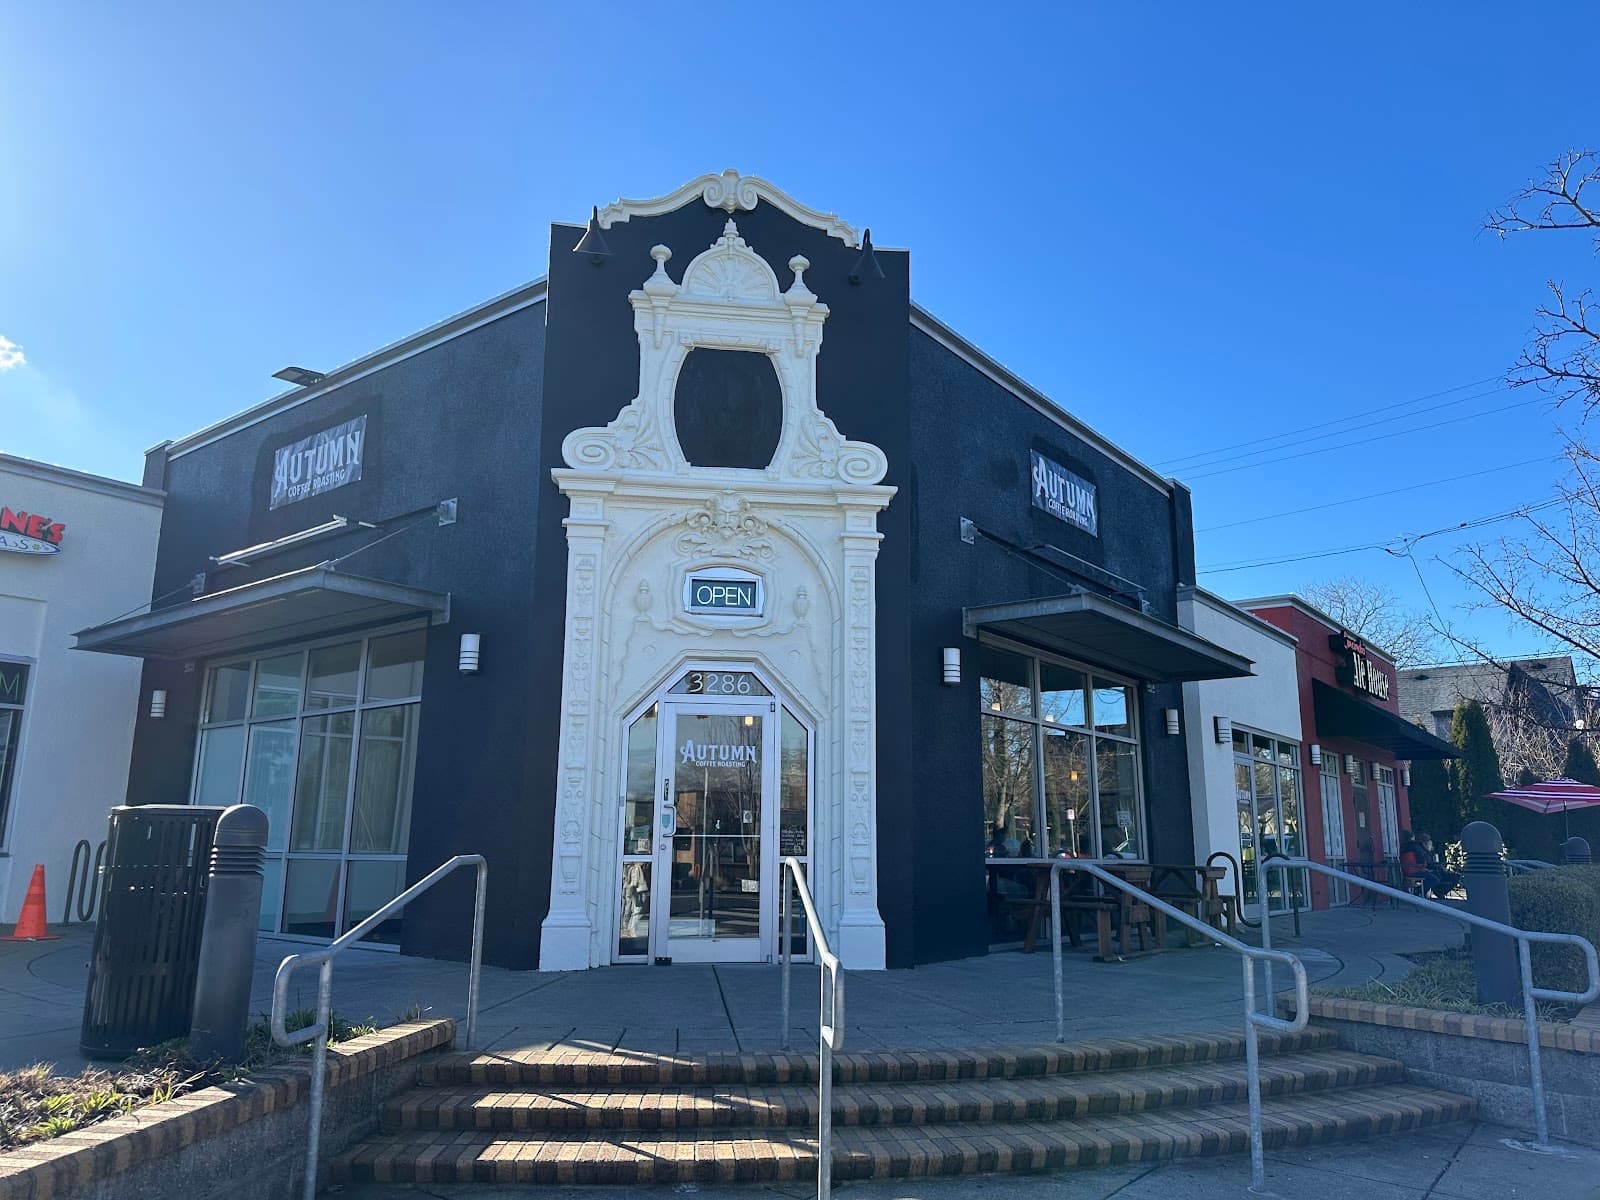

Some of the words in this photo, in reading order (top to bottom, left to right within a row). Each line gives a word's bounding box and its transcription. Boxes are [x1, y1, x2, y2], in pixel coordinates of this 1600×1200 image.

[273, 431, 361, 498] AUTUMN
[287, 480, 312, 498] COFFEE
[312, 469, 345, 490] ROASTING
[1032, 456, 1096, 525] AUTUMN
[1065, 507, 1089, 527] ROAING
[696, 585, 752, 607] OPEN
[688, 673, 750, 694] 3286
[1352, 651, 1367, 690] Ale
[1366, 659, 1390, 701] House
[680, 739, 758, 764] AUTUMN
[695, 760, 716, 768] COFFEE
[717, 760, 746, 768] ROASTING
